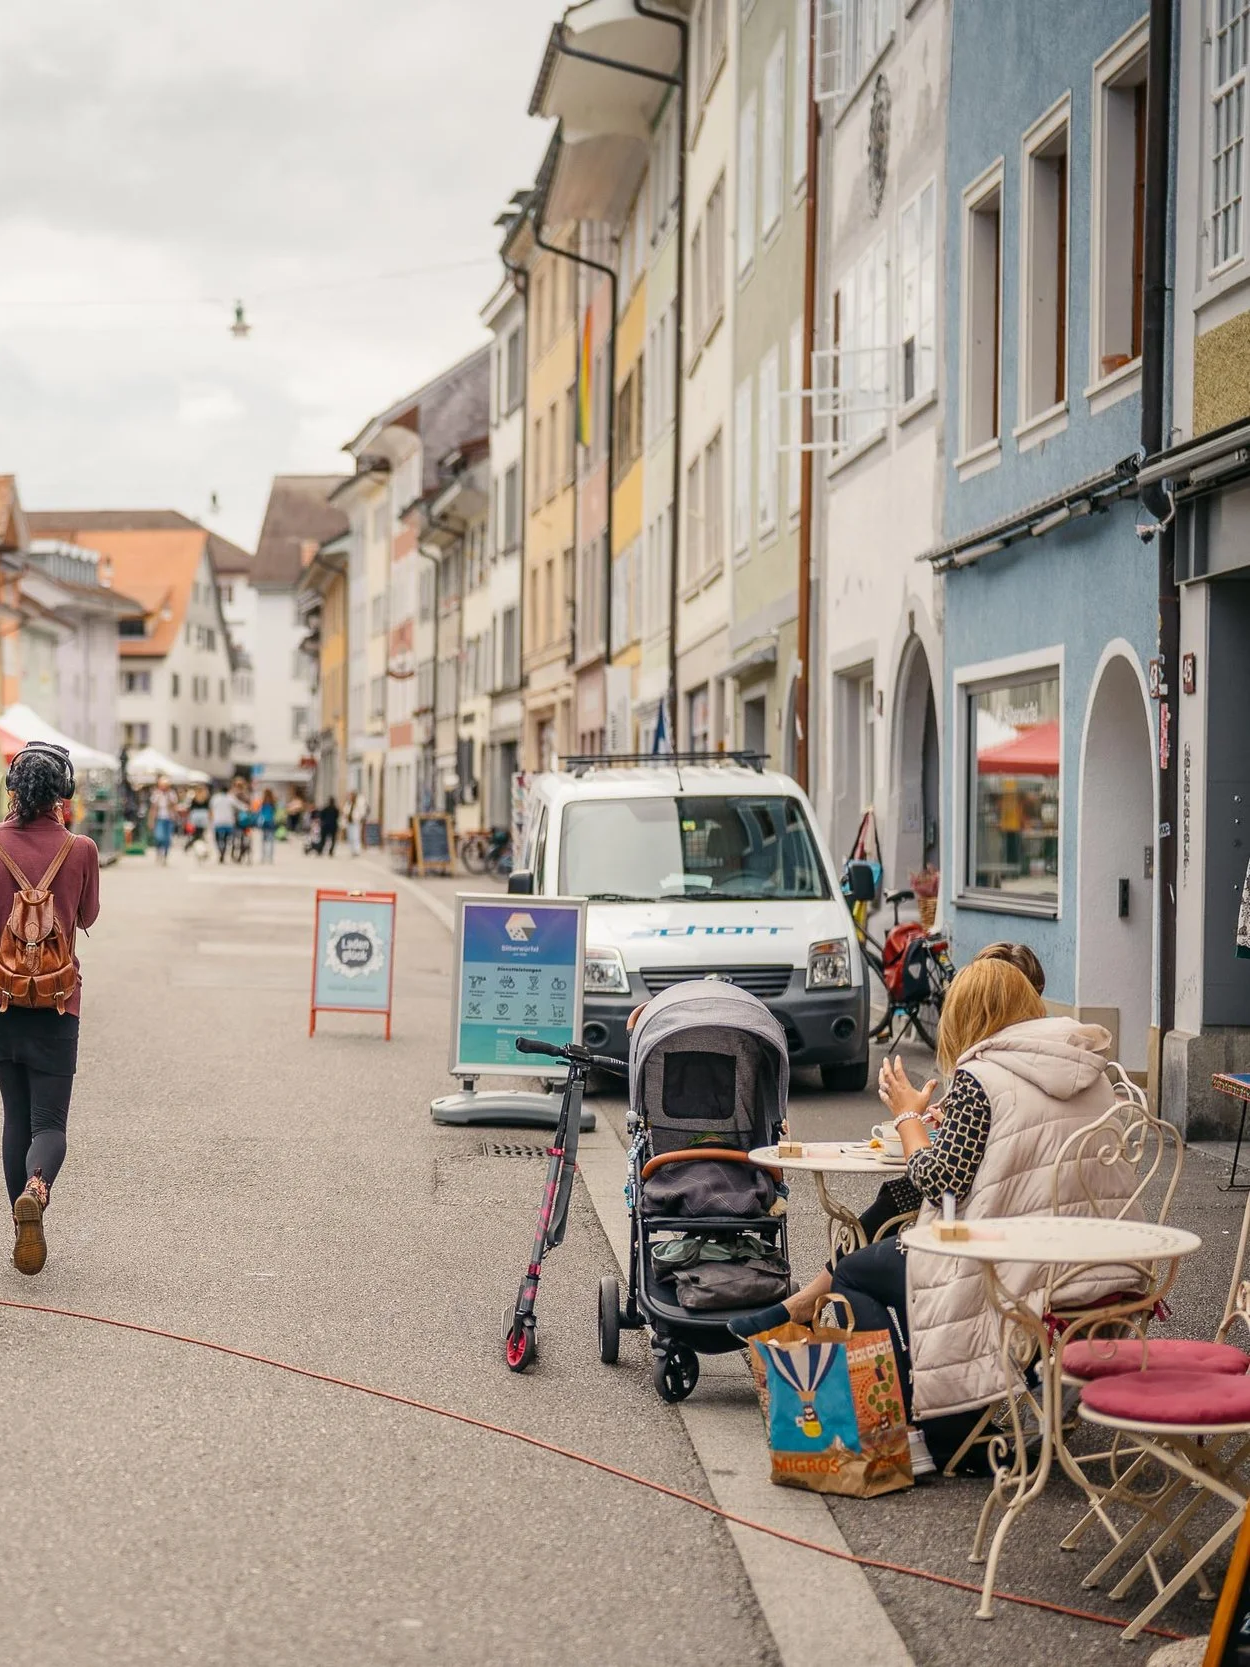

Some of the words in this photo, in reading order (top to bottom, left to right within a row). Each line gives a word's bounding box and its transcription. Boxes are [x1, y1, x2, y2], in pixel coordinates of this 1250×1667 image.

[1183, 659, 1193, 682] 45
[340, 937, 370, 950] Laden
[341, 949, 368, 963] glück
[773, 1456, 840, 1474] MIGROS
